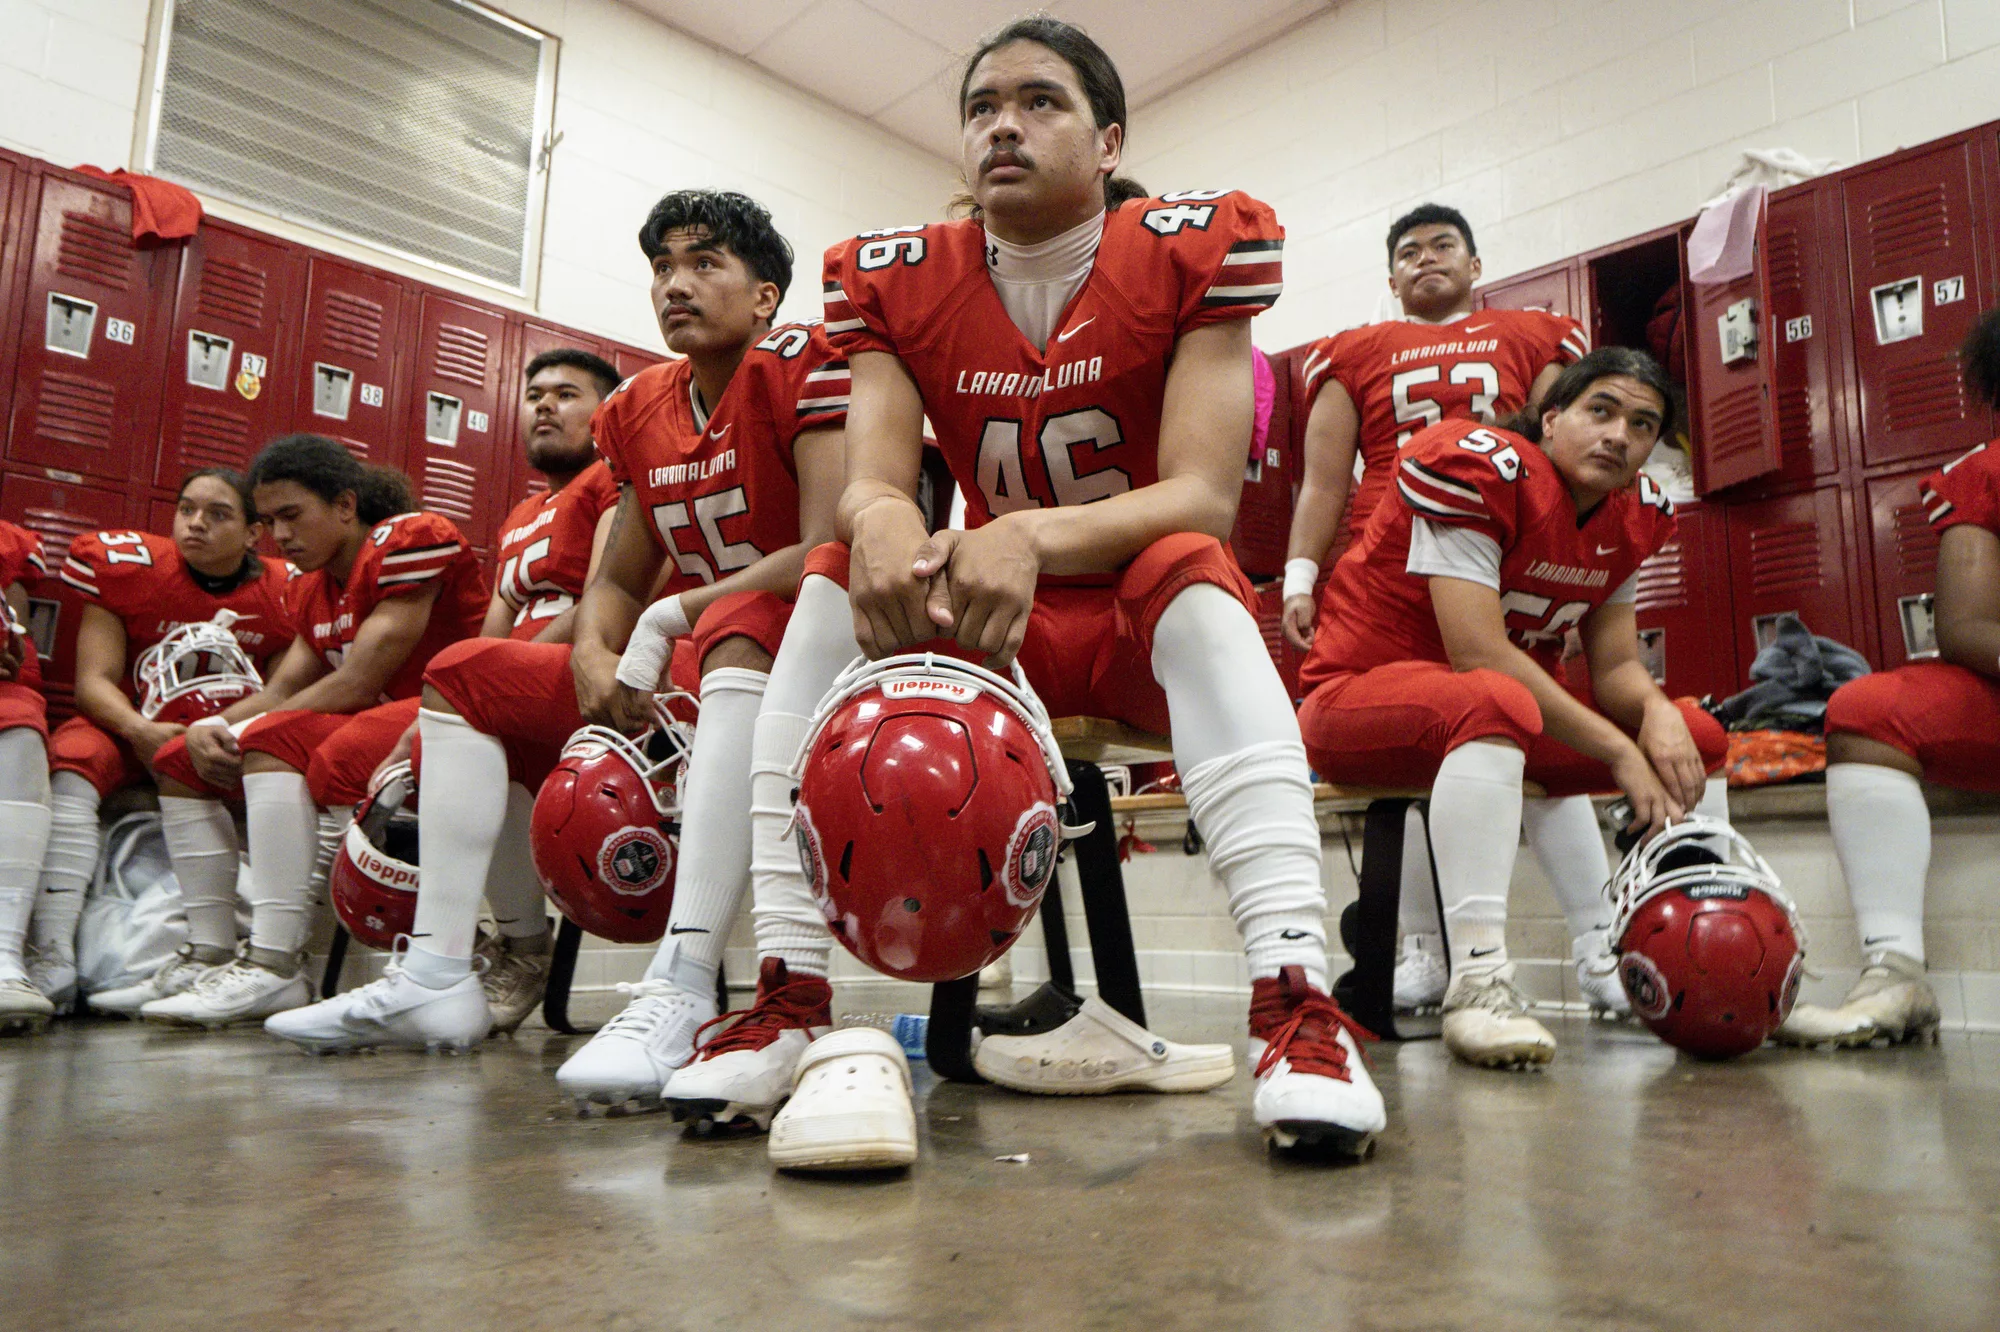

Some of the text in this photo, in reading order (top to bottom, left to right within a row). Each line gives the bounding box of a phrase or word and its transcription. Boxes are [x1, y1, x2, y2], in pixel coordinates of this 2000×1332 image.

[1937, 279, 1963, 304] 57
[109, 320, 132, 342] 36
[1788, 318, 1811, 340] 56
[1391, 338, 1498, 365] LAHAINALUNA
[243, 355, 265, 376] 37
[363, 386, 382, 405] 38
[470, 413, 487, 430] 40
[357, 850, 419, 888] iddell
